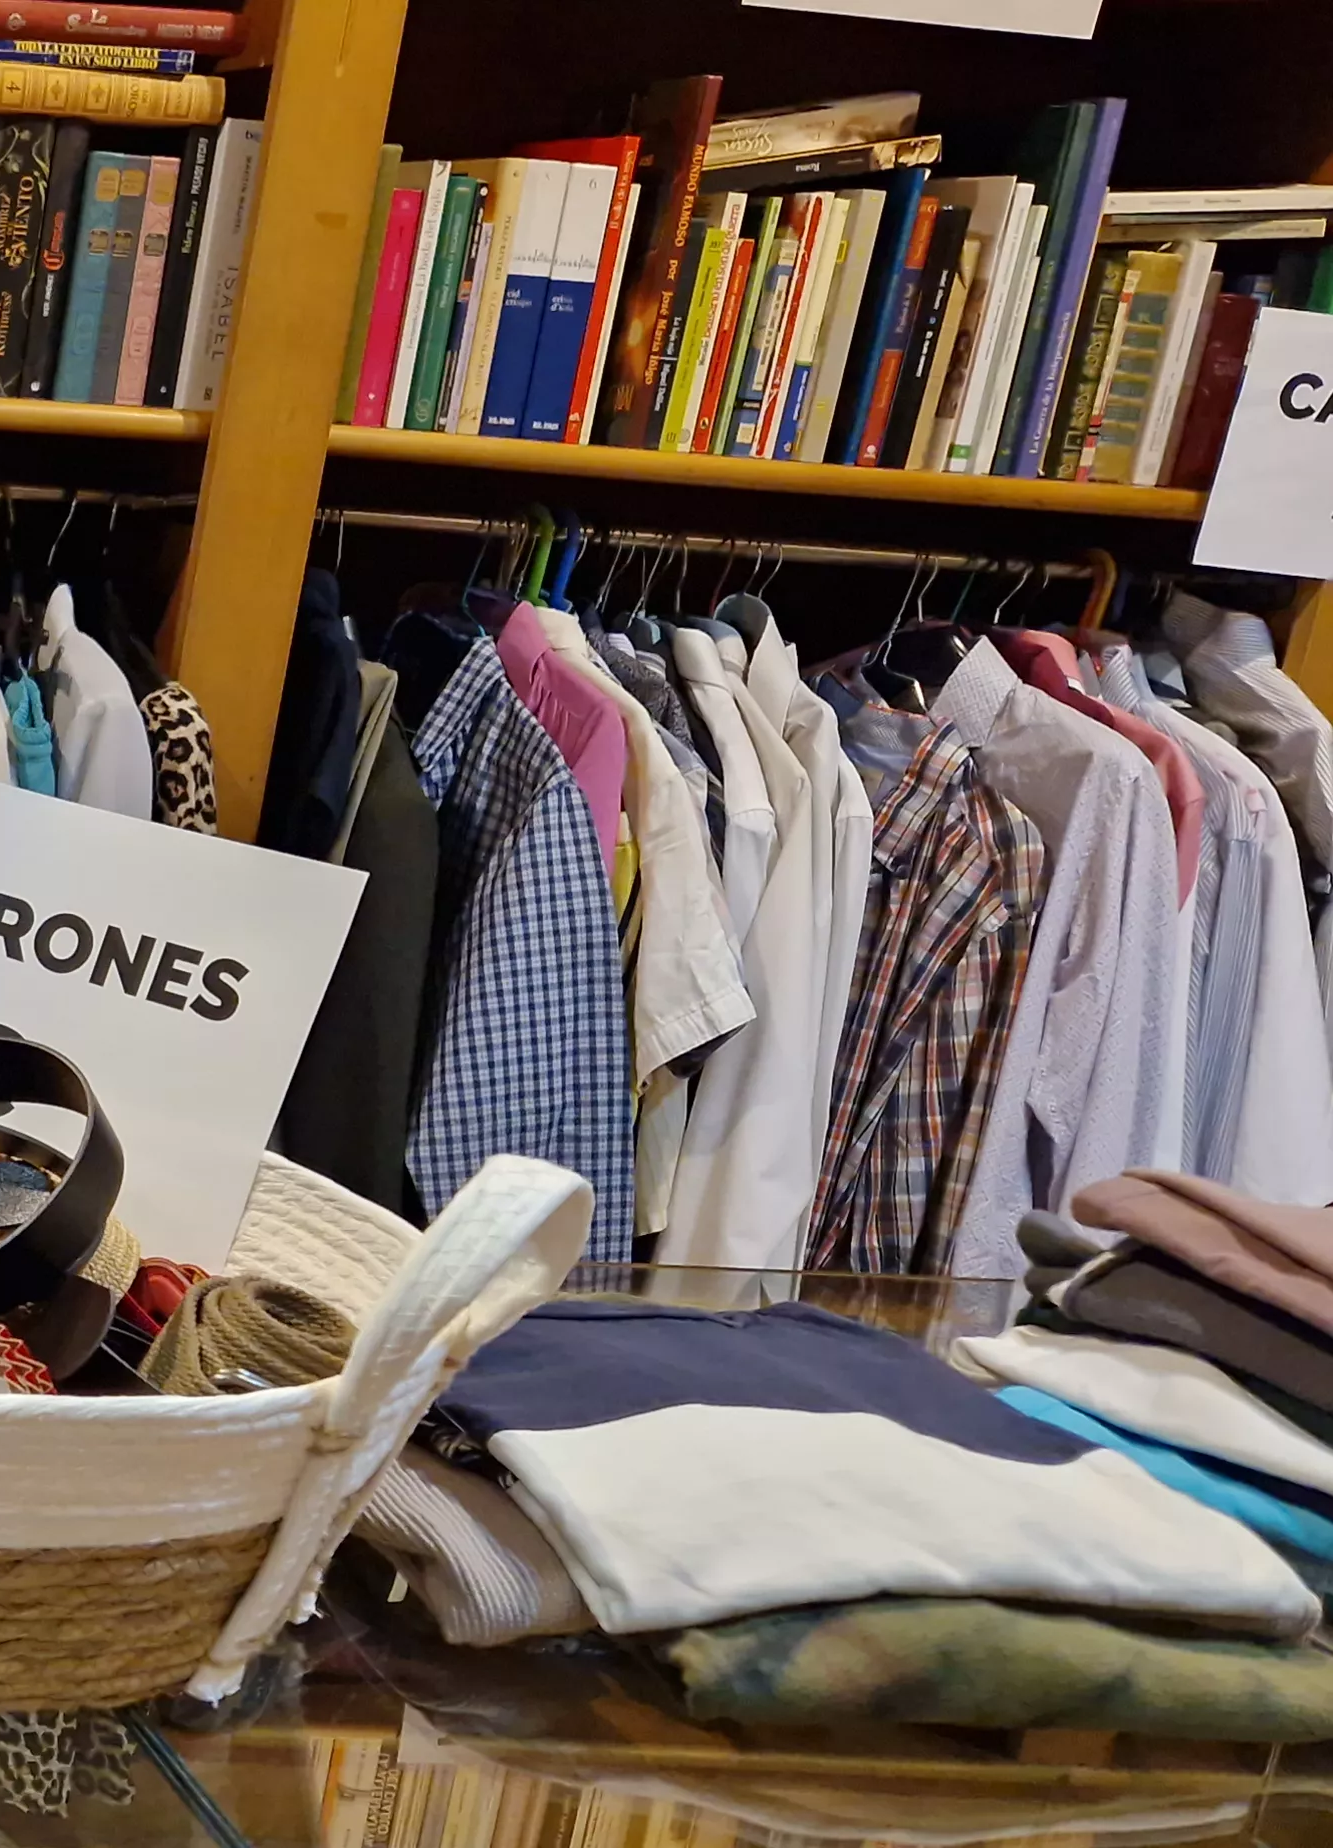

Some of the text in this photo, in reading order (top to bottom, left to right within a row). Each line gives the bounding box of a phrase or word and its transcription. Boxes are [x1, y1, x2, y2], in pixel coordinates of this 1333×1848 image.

[14, 41, 44, 55] TODA
[59, 53, 158, 70] EN UN SOLO LIBRO
[190, 166, 205, 195] PASADO
[589, 178, 597, 189] 6
[795, 161, 820, 172] Roma
[11, 175, 34, 249] VIENTO
[674, 143, 706, 248] MUNDO FAMOSO
[211, 265, 239, 361] ISABEL
[651, 259, 679, 352] por José María
[1028, 311, 1072, 454] La Guerra de la Independencia
